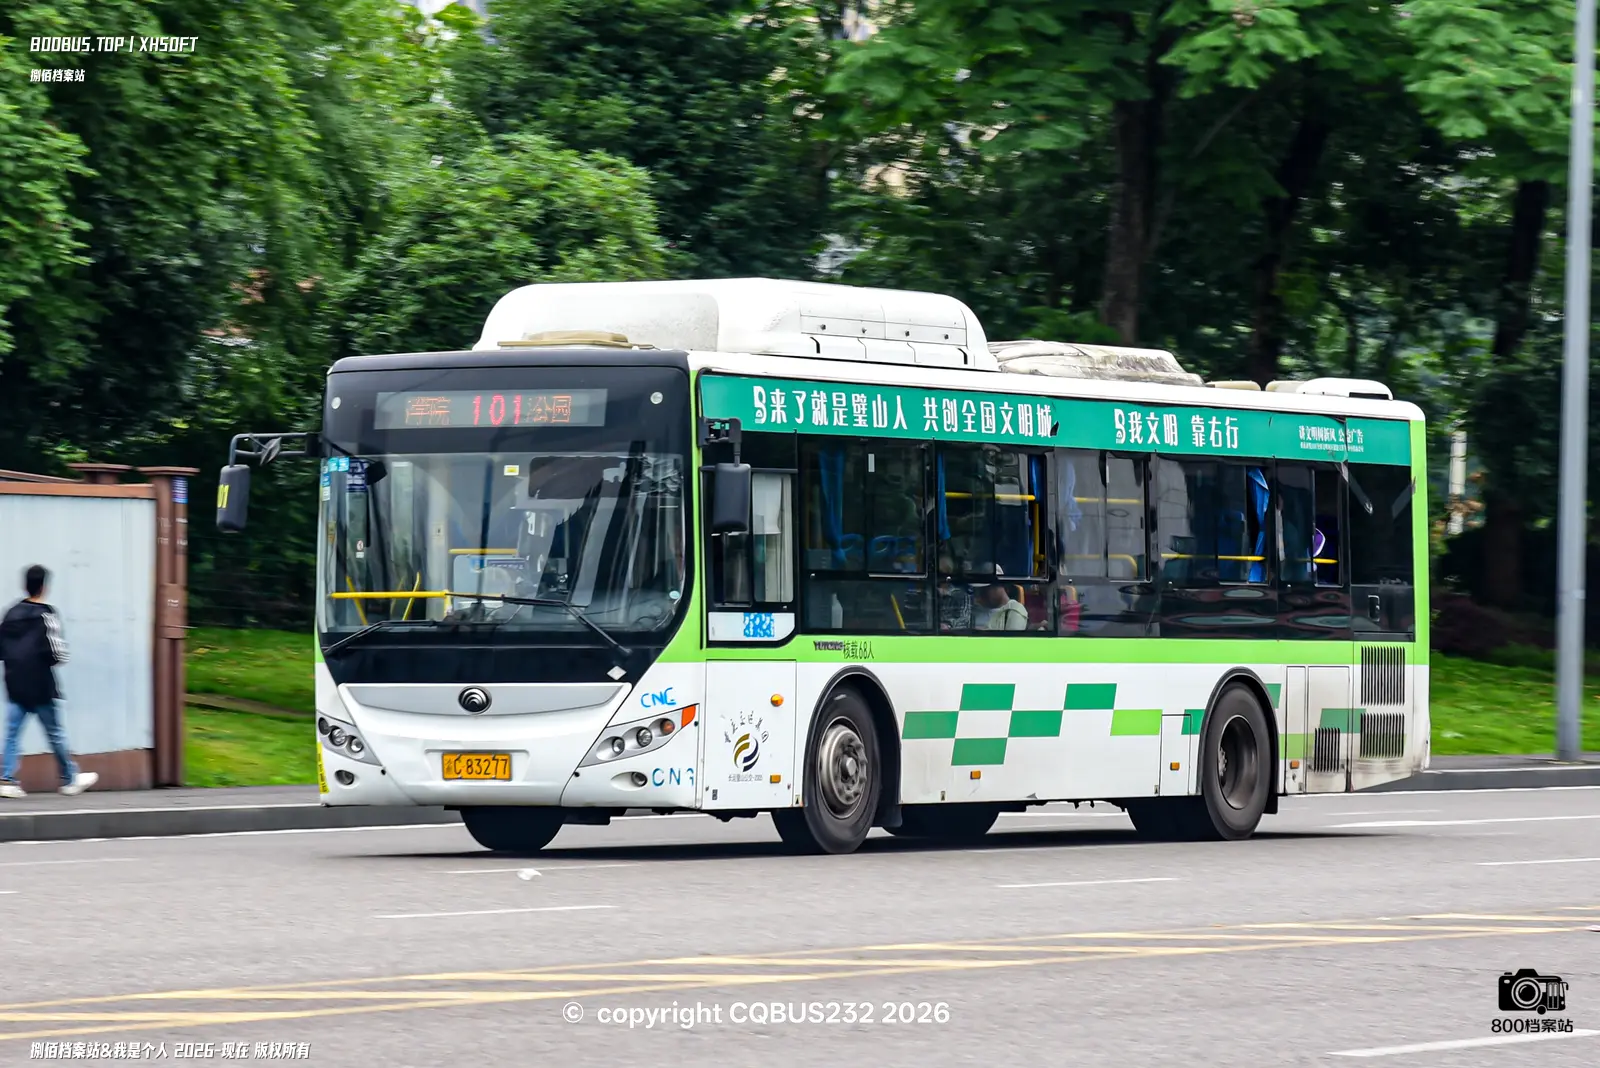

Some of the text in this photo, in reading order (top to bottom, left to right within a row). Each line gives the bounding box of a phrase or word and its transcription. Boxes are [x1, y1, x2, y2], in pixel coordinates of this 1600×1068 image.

[472, 394, 522, 426] 101
[769, 388, 908, 430] 来了就是璧山人
[1128, 411, 1239, 449] 我文明 靠右行
[843, 640, 875, 660] 核载68人
